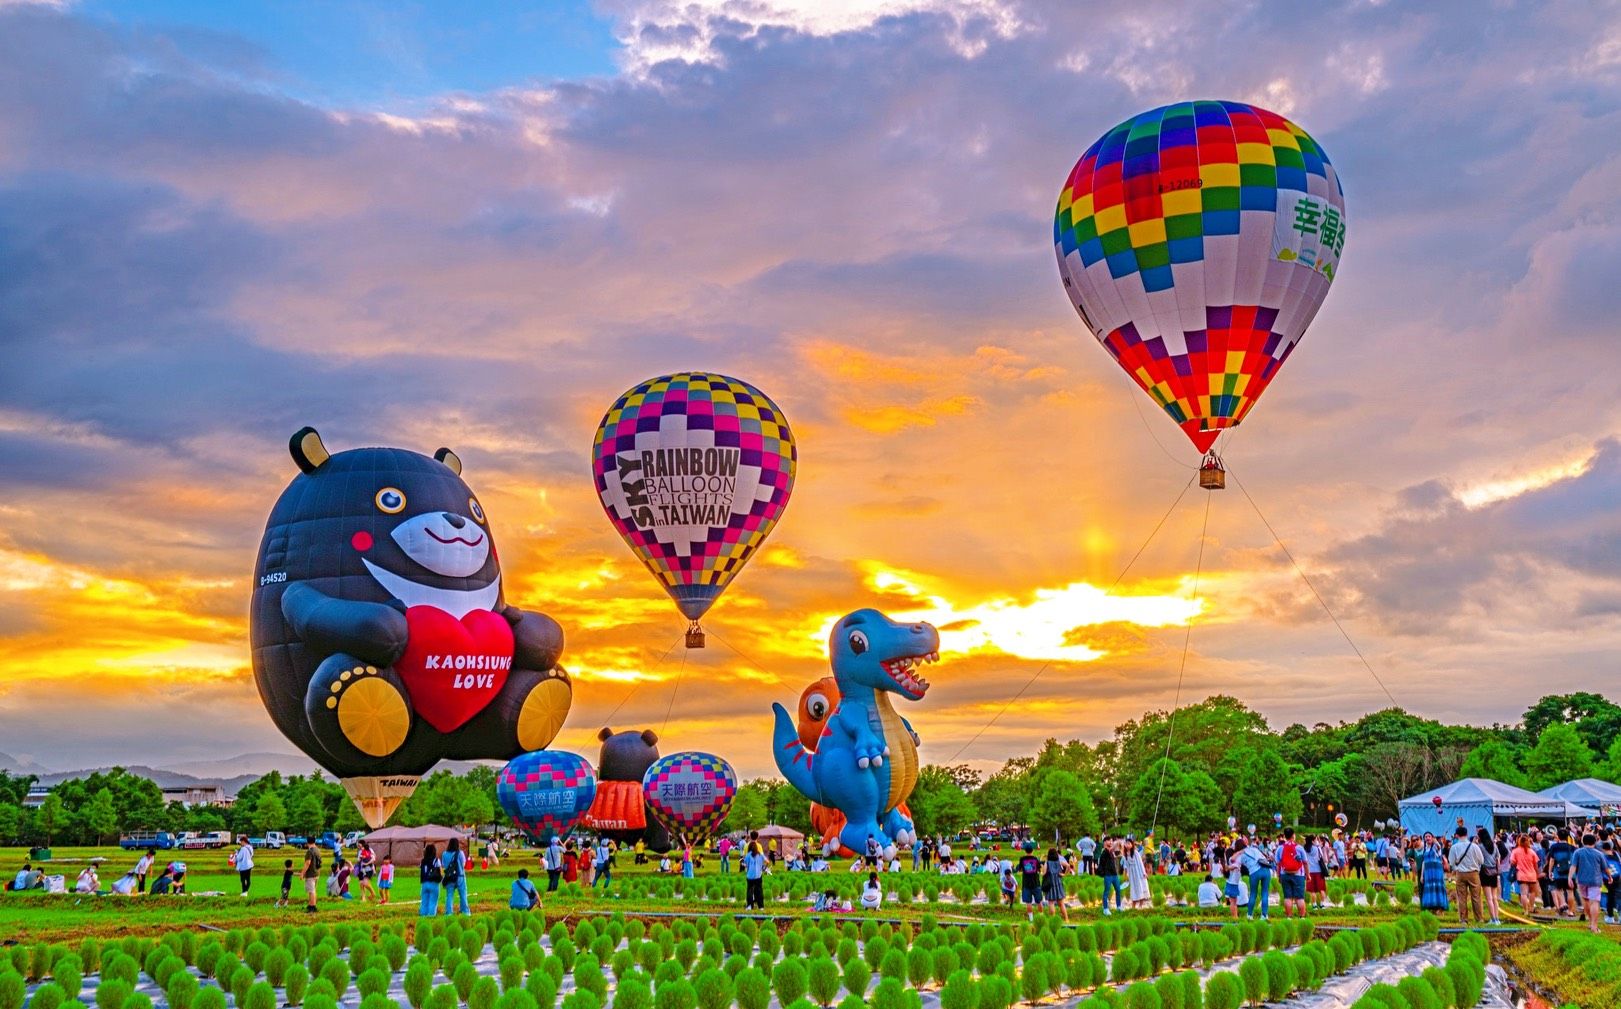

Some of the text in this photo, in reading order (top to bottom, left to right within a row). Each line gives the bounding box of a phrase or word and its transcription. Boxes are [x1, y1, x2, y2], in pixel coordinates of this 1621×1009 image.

[641, 448, 740, 478] RAINBOW
[617, 455, 655, 527] SKY
[645, 476, 736, 494] BALLOON
[649, 493, 733, 506] FLIGHTS
[659, 505, 730, 526] TAIWAN
[260, 571, 287, 587] B-94520
[425, 654, 512, 671] KAOHSIUNG
[453, 673, 495, 689] LOVE
[662, 782, 712, 797] 天際航空
[519, 790, 575, 807] 天際航空
